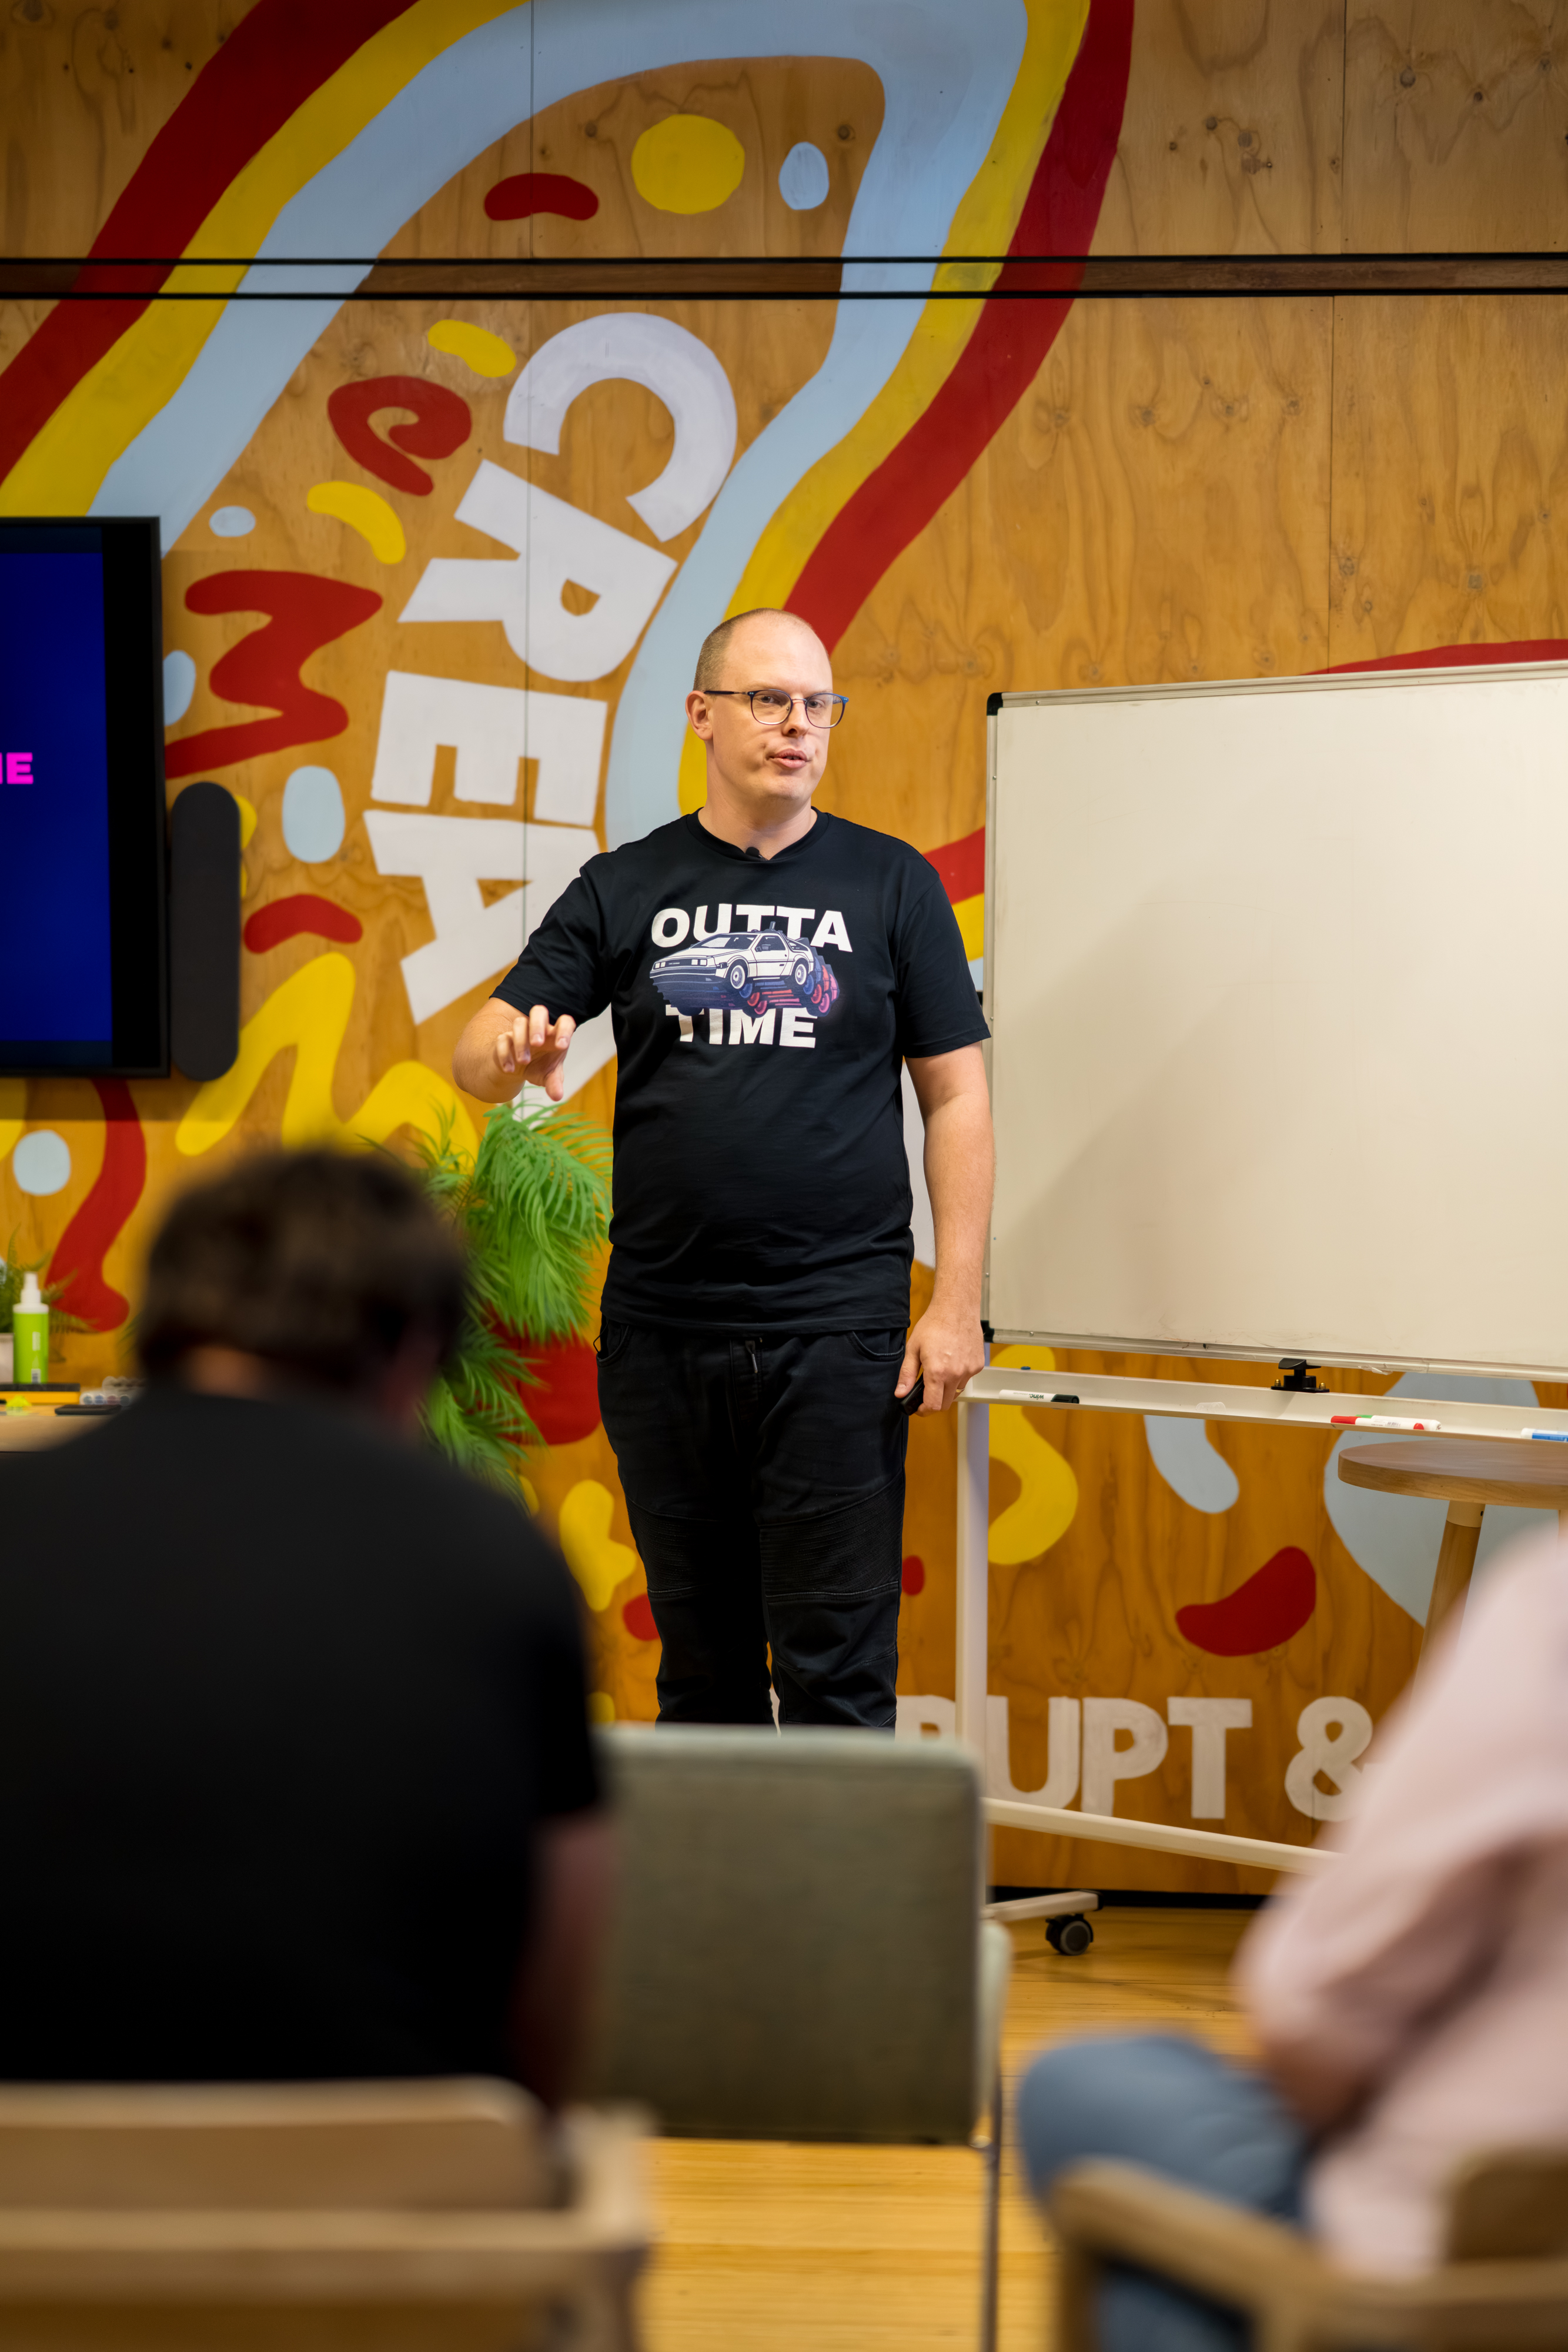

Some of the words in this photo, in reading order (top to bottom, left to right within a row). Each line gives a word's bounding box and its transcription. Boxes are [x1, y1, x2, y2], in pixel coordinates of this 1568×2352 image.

[363, 312, 738, 1121] CREA
[651, 903, 853, 953] OUTTA
[665, 1004, 818, 1048] TIME
